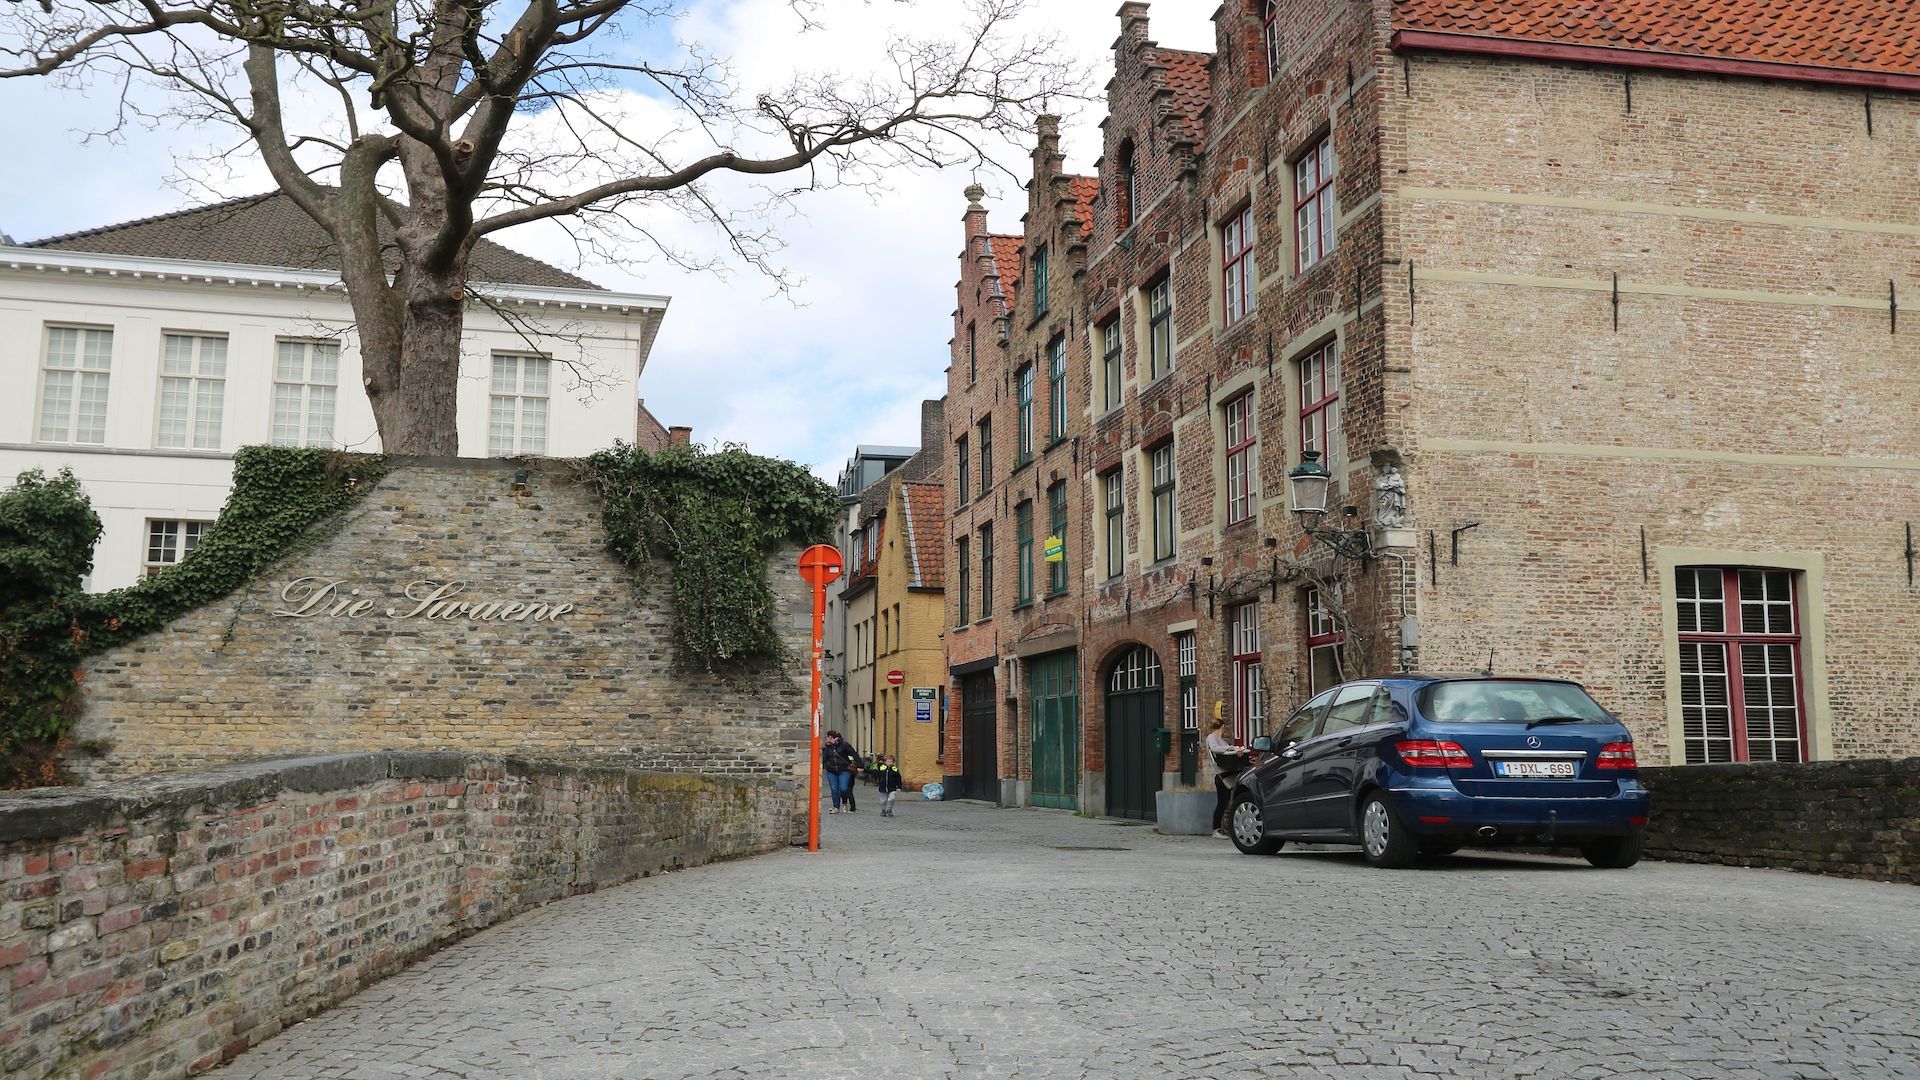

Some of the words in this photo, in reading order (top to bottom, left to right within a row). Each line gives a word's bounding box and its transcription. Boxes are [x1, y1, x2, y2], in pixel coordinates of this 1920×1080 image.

[271, 576, 374, 618] Die
[385, 580, 575, 622] Swaene
[1505, 763, 1572, 774] 1-DXL-669
